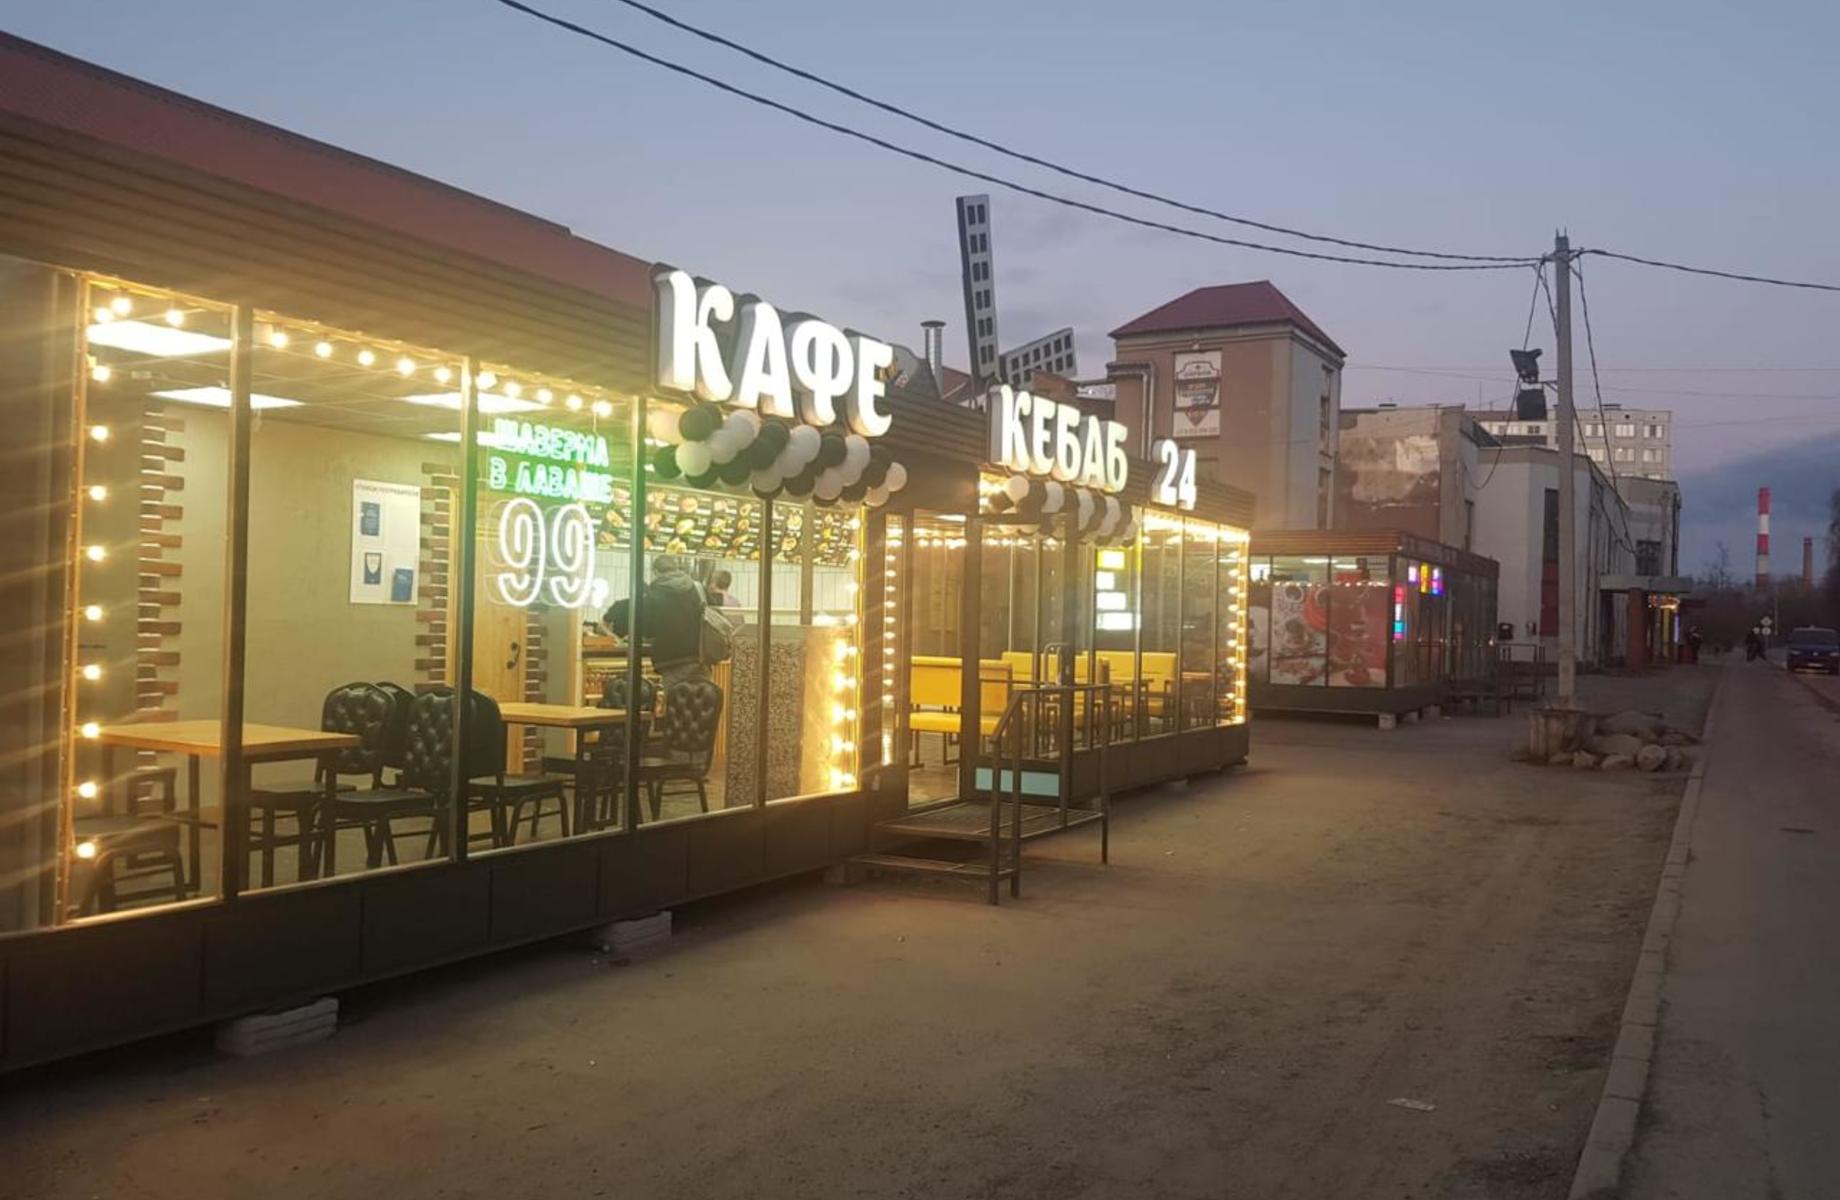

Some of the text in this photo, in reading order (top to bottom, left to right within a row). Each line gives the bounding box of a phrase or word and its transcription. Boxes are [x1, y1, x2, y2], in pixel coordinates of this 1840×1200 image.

[660, 269, 894, 437] КАФЕ
[490, 457, 613, 504] В ЛАВАШЕ
[494, 418, 610, 467] ШАВЕРМА
[994, 385, 1197, 510] КЕБАБ 24
